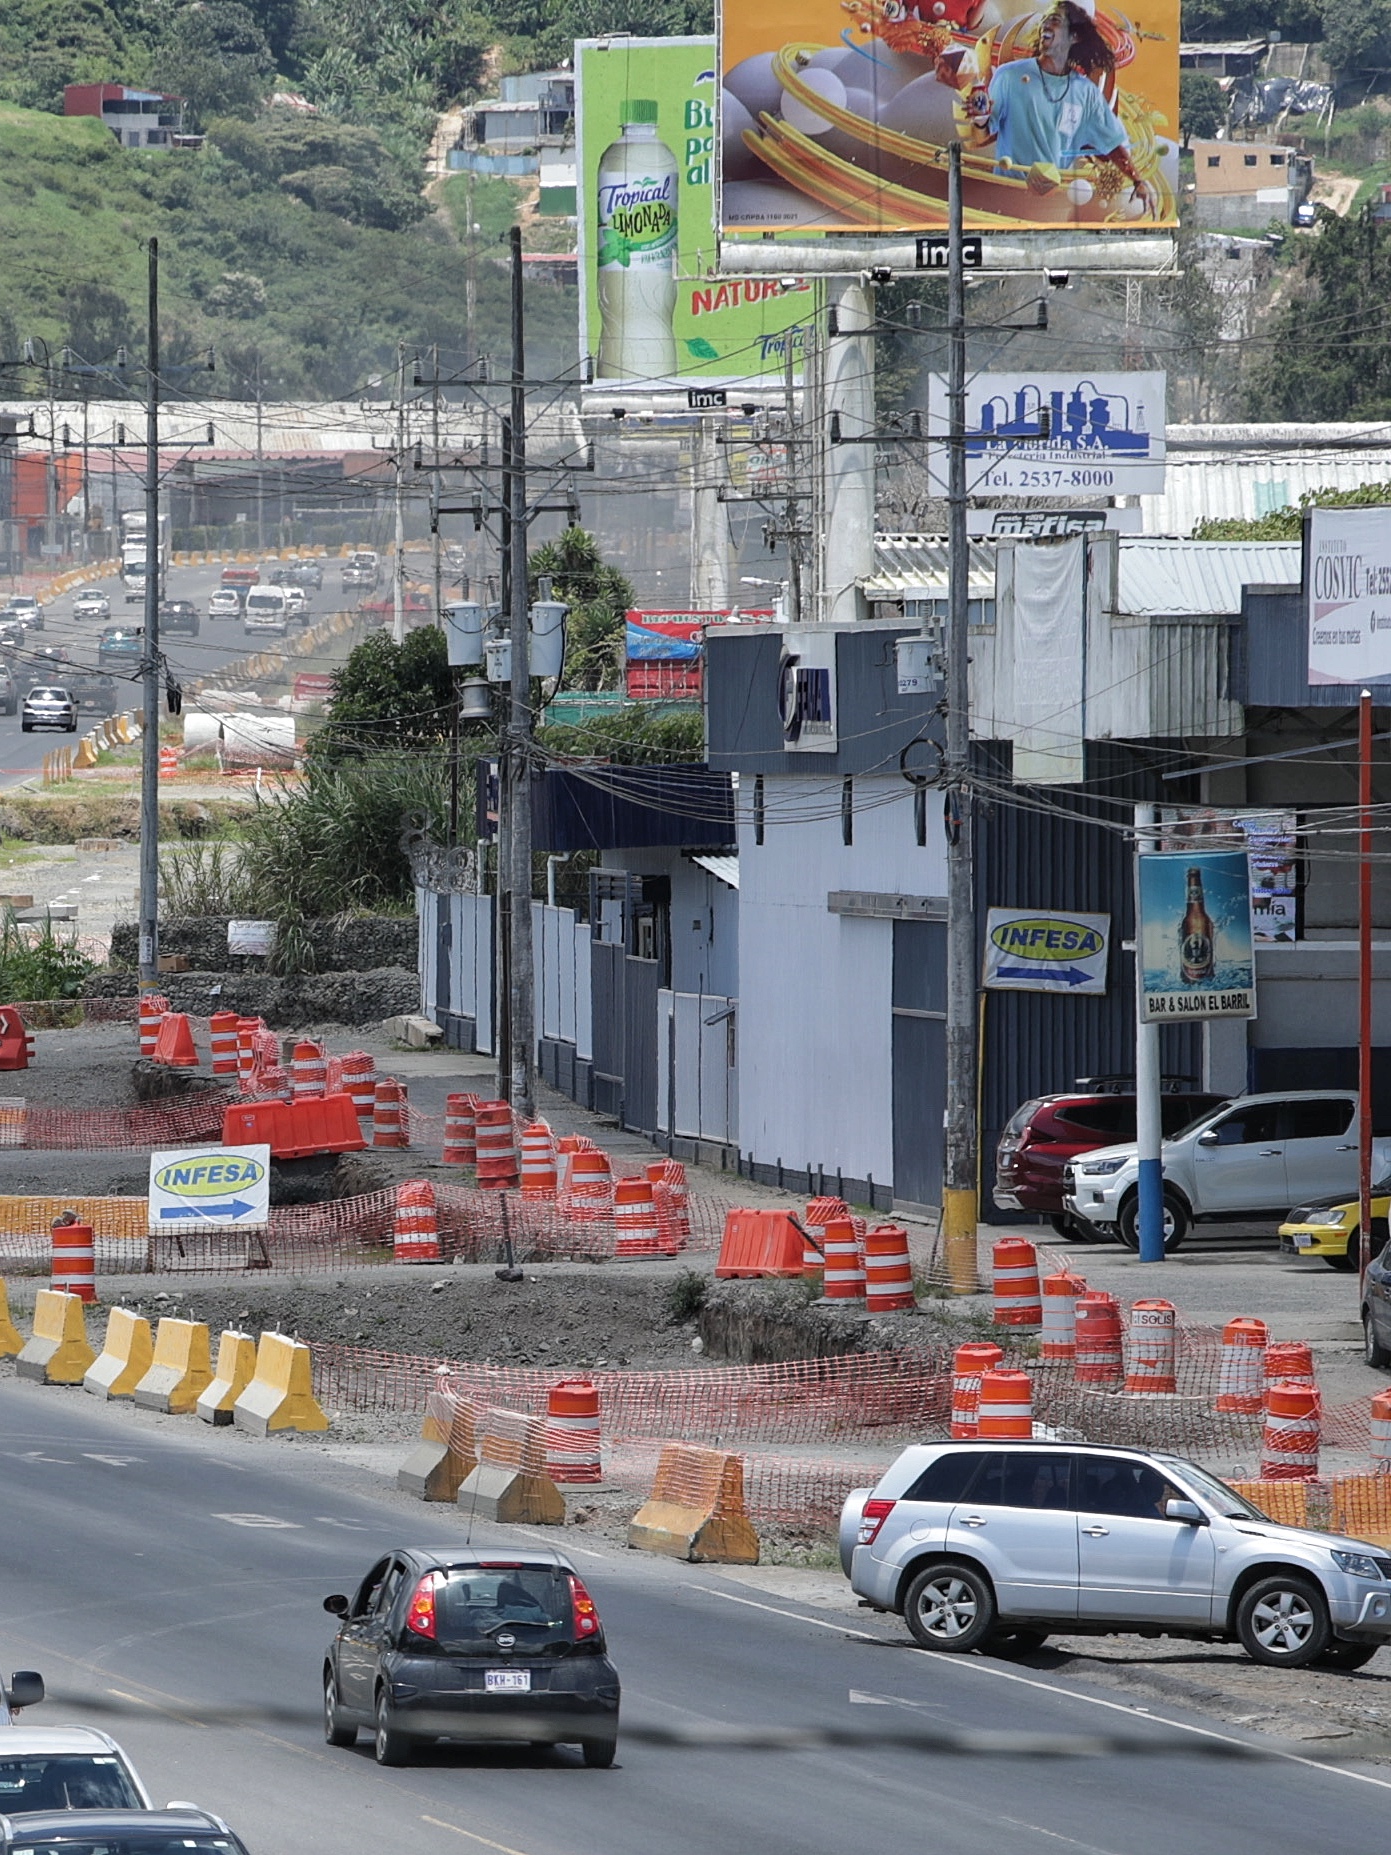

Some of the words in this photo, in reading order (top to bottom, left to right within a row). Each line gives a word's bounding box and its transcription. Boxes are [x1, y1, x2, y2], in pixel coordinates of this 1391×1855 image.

[598, 175, 671, 214] Tropical
[611, 203, 671, 237] LIMONADA
[921, 241, 976, 266] imc
[691, 391, 723, 406] imc
[1076, 432, 1109, 450] S.A.
[1049, 449, 1106, 460] Industrial
[983, 471, 1013, 487] Tel.
[1019, 470, 1114, 488] 2537-8000
[1314, 555, 1363, 600] COSVIC
[999, 927, 1097, 952] INFESA
[1149, 996, 1166, 1013] BAR
[1168, 996, 1175, 1012] &
[1177, 995, 1207, 1011] SALON
[1208, 995, 1220, 1011] EL
[1221, 992, 1250, 1010] BARRIL
[163, 1163, 258, 1187] INFESA
[1141, 1314, 1172, 1325] SOLIS
[487, 1674, 528, 1686] BKH-161
